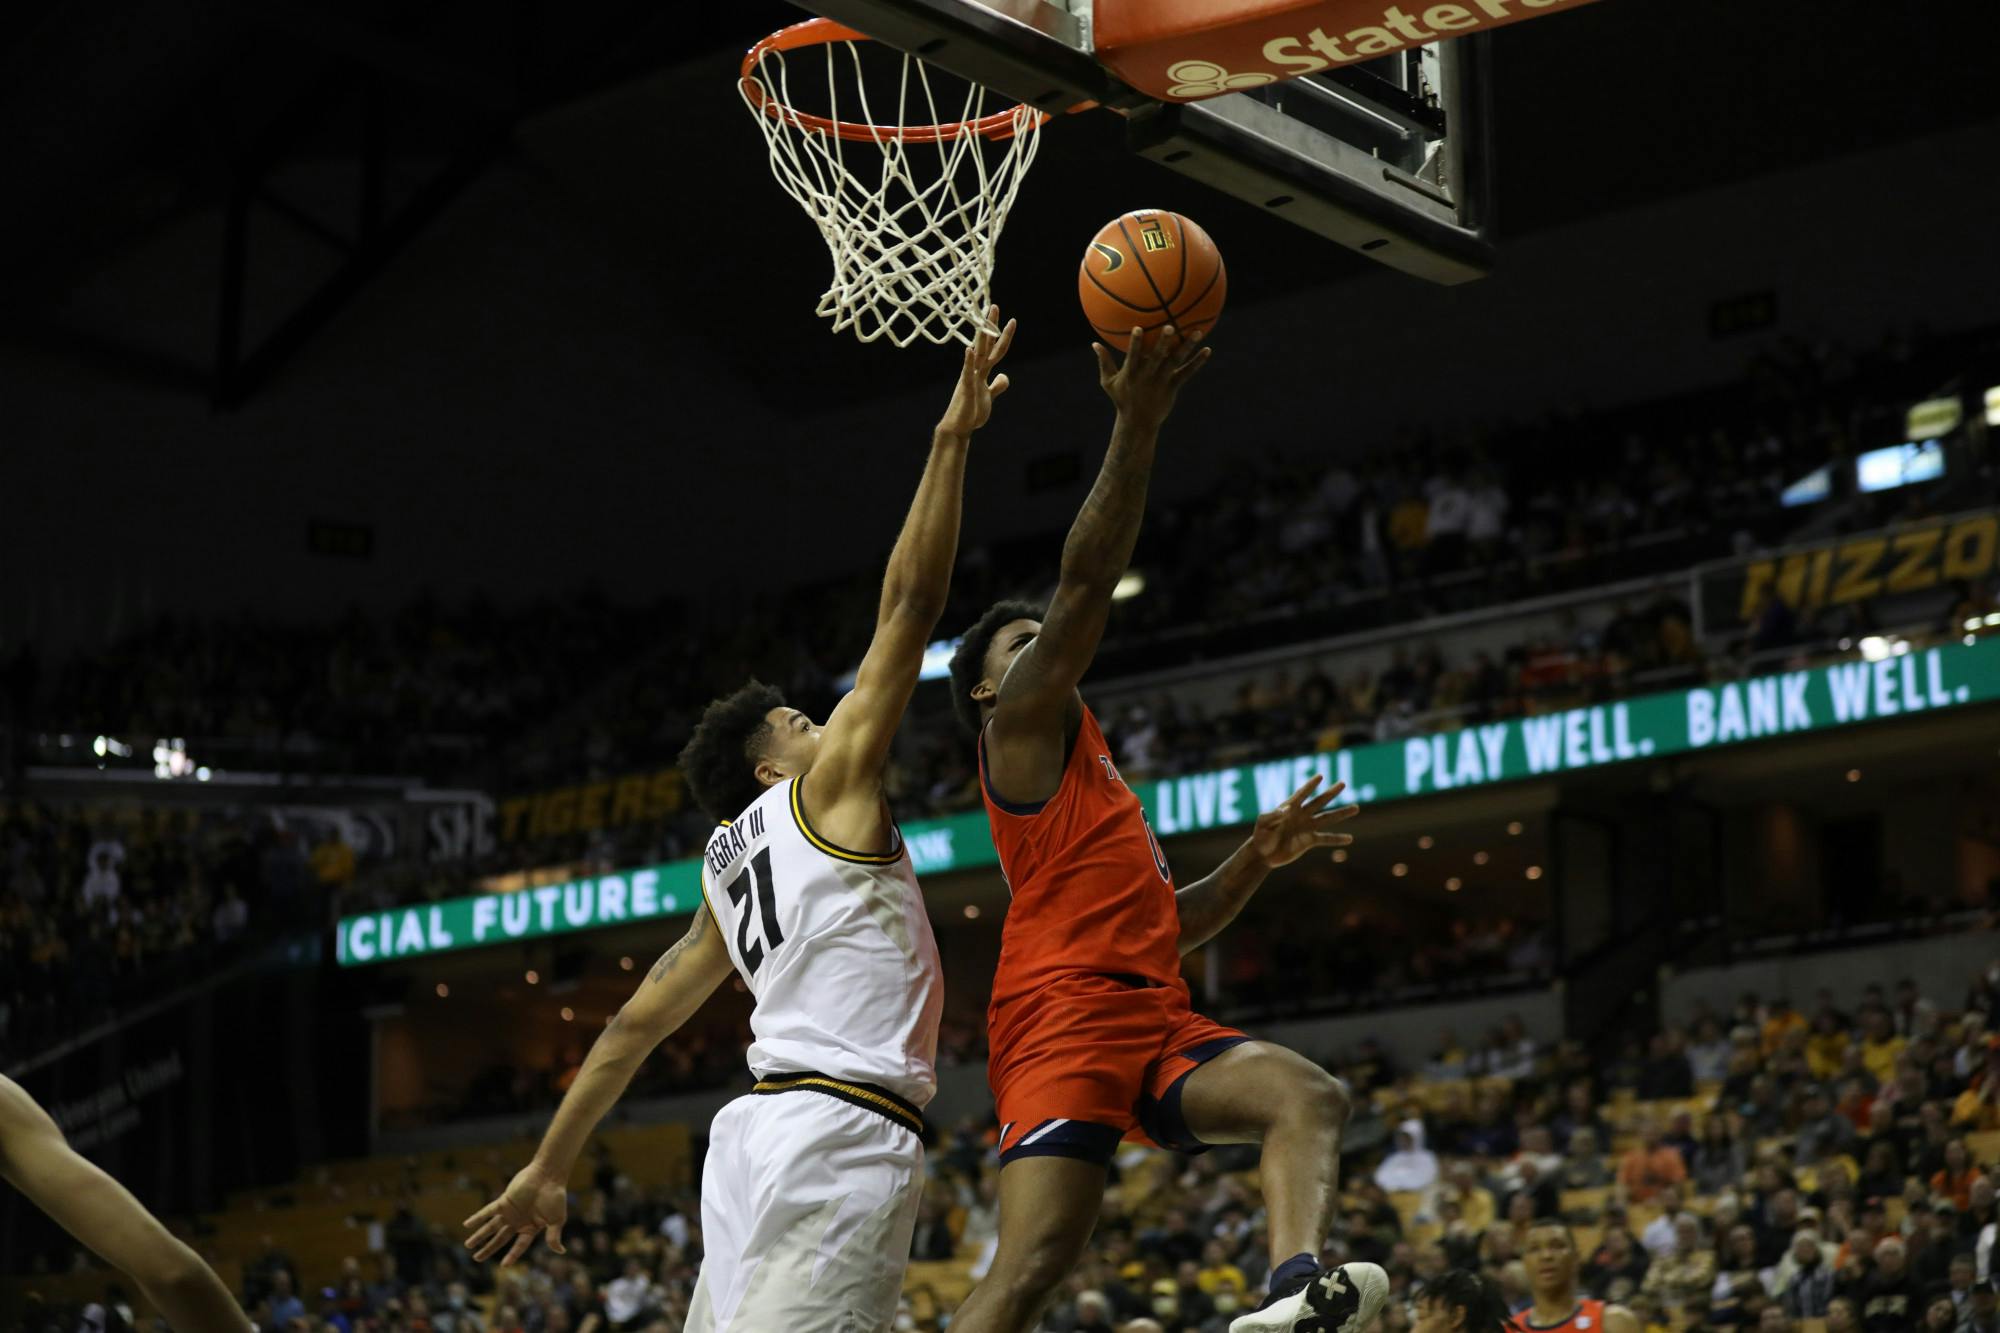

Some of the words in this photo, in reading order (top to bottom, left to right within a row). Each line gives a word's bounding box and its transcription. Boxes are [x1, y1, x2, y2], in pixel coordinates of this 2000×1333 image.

[1156, 767, 1242, 834] LIVE
[1253, 750, 1376, 816] WELL.
[1404, 722, 1508, 794] PLAY
[1521, 702, 1655, 775] WELL.
[1687, 670, 1812, 747] BANK
[1826, 648, 1970, 723] WELL.
[501, 769, 684, 842] TIGERS
[749, 806, 765, 839] III
[338, 905, 453, 962] CIAL
[472, 870, 677, 942] FUTURE.
[726, 845, 785, 978] 21
